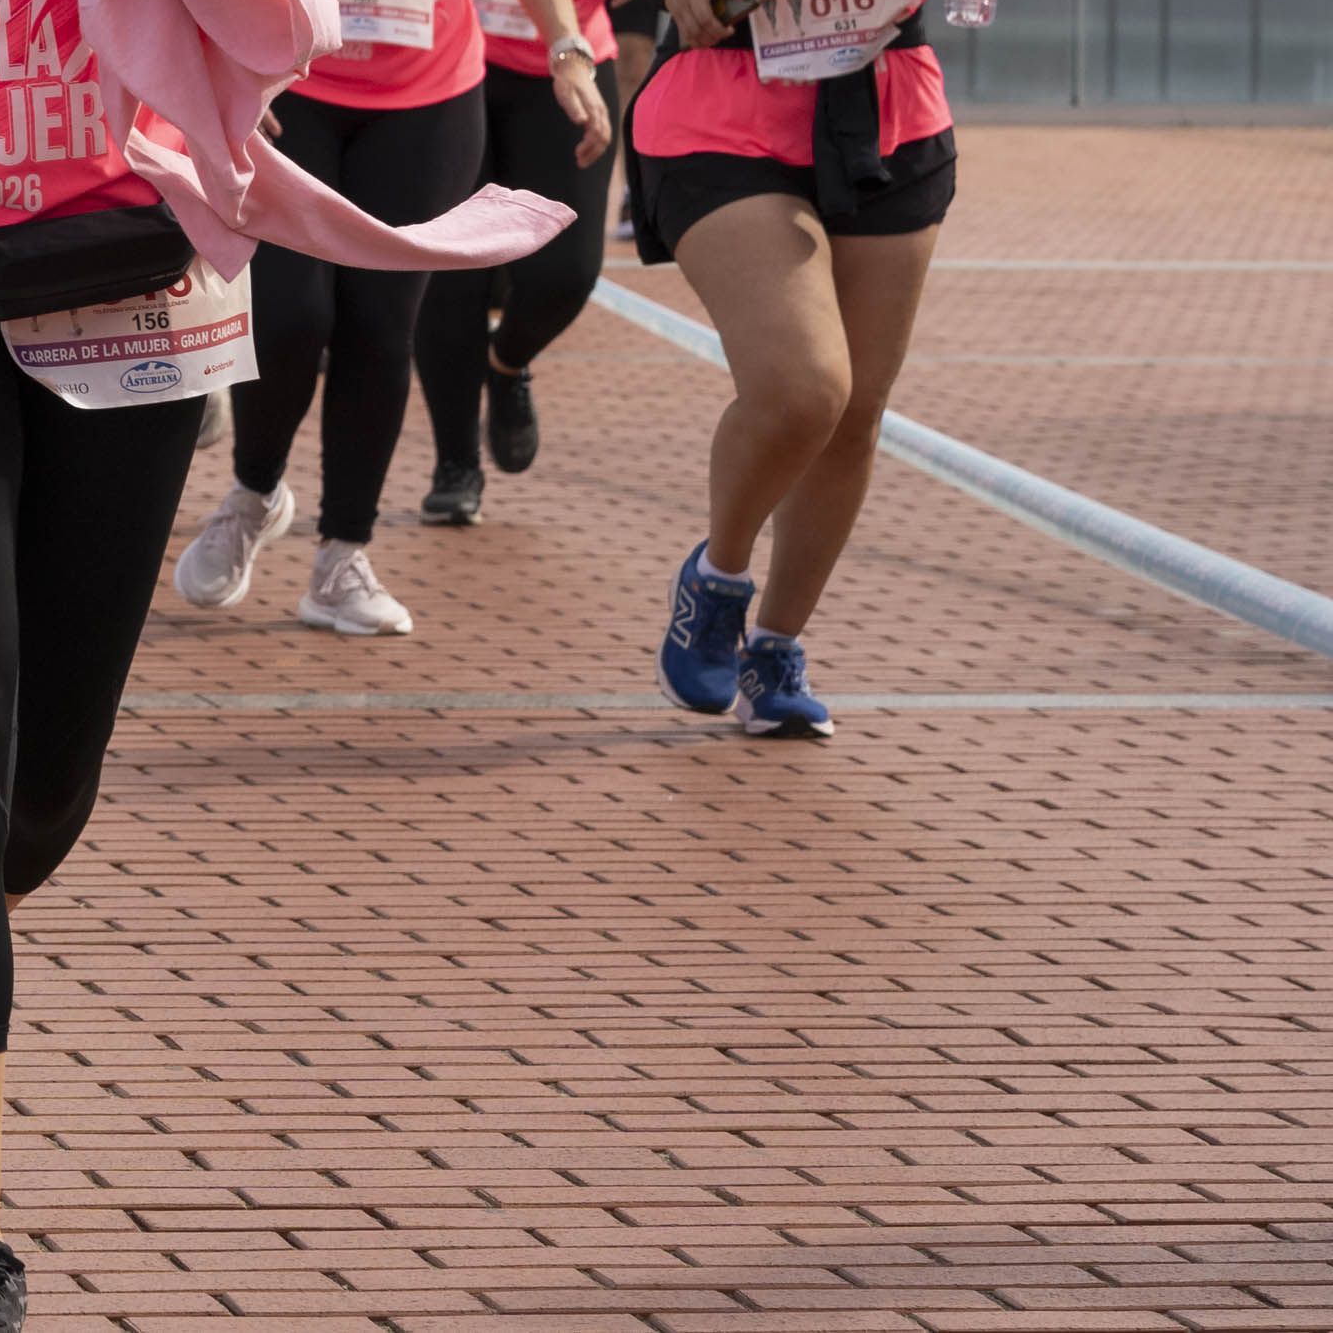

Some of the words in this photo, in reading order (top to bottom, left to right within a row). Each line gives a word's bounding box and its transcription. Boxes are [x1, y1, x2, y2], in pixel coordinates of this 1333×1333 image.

[835, 19, 858, 31] 631
[132, 312, 170, 331] 156
[21, 347, 77, 363] CARRERA
[81, 345, 100, 359] DE
[103, 342, 121, 357] LA
[124, 338, 171, 355] MUJER
[180, 332, 209, 349] GRAN
[211, 325, 243, 342] CANARIA
[125, 373, 178, 387] ASTURIANA
